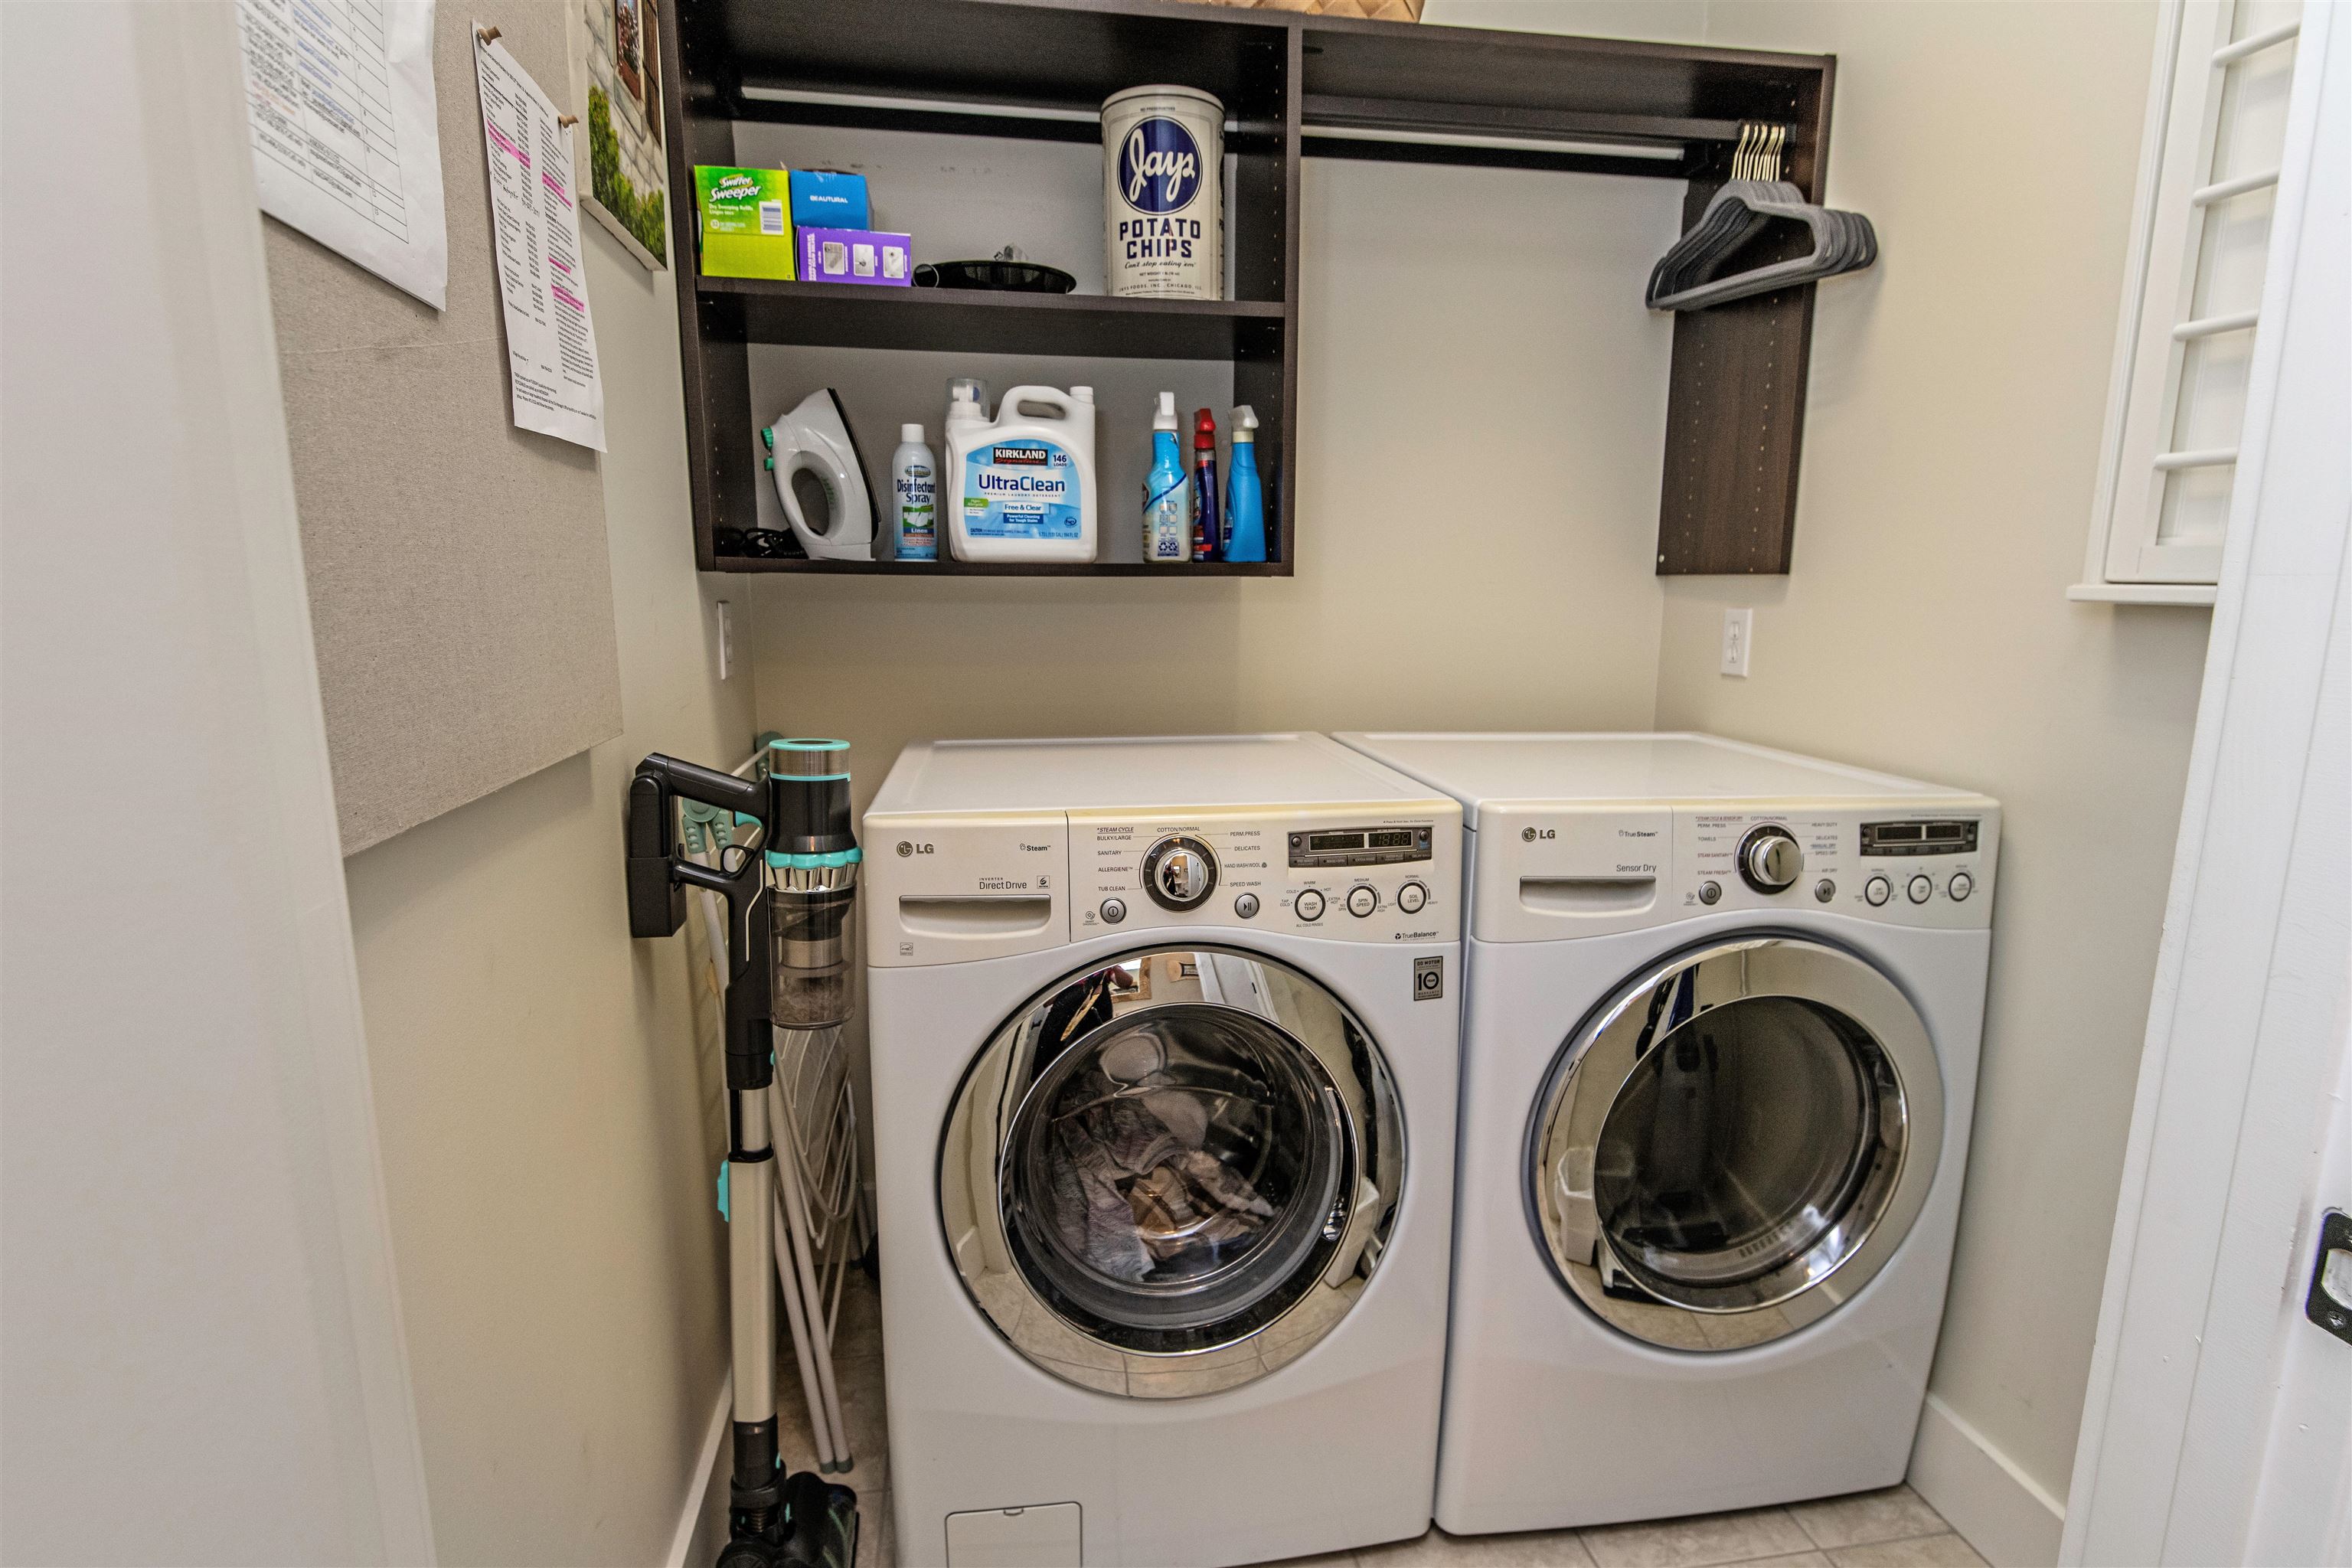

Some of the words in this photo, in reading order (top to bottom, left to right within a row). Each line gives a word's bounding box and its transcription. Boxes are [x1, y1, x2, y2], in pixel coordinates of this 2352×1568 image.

[1129, 128, 1195, 202] Jays
[720, 177, 752, 188] Swiffer
[709, 186, 762, 202] Sweeper
[810, 195, 848, 204] BEAUTURAL
[1119, 217, 1200, 241] POTATO
[1126, 239, 1192, 260] CHIPS
[1142, 260, 1157, 269] stop
[1159, 260, 1182, 269] eating
[995, 449, 1047, 459] KIRKLAND
[1054, 455, 1067, 463] 146
[897, 479, 936, 494] Disinfectant
[978, 474, 1066, 492] UltraClean
[906, 492, 931, 505] Spray
[1539, 829, 1556, 839] LG
[916, 843, 934, 854] LG
[1616, 864, 1642, 873] Sensor
[1643, 864, 1657, 874] Dry
[979, 881, 1004, 890] Direct
[1005, 880, 1027, 890] Drive
[1417, 971, 1439, 991] 10
